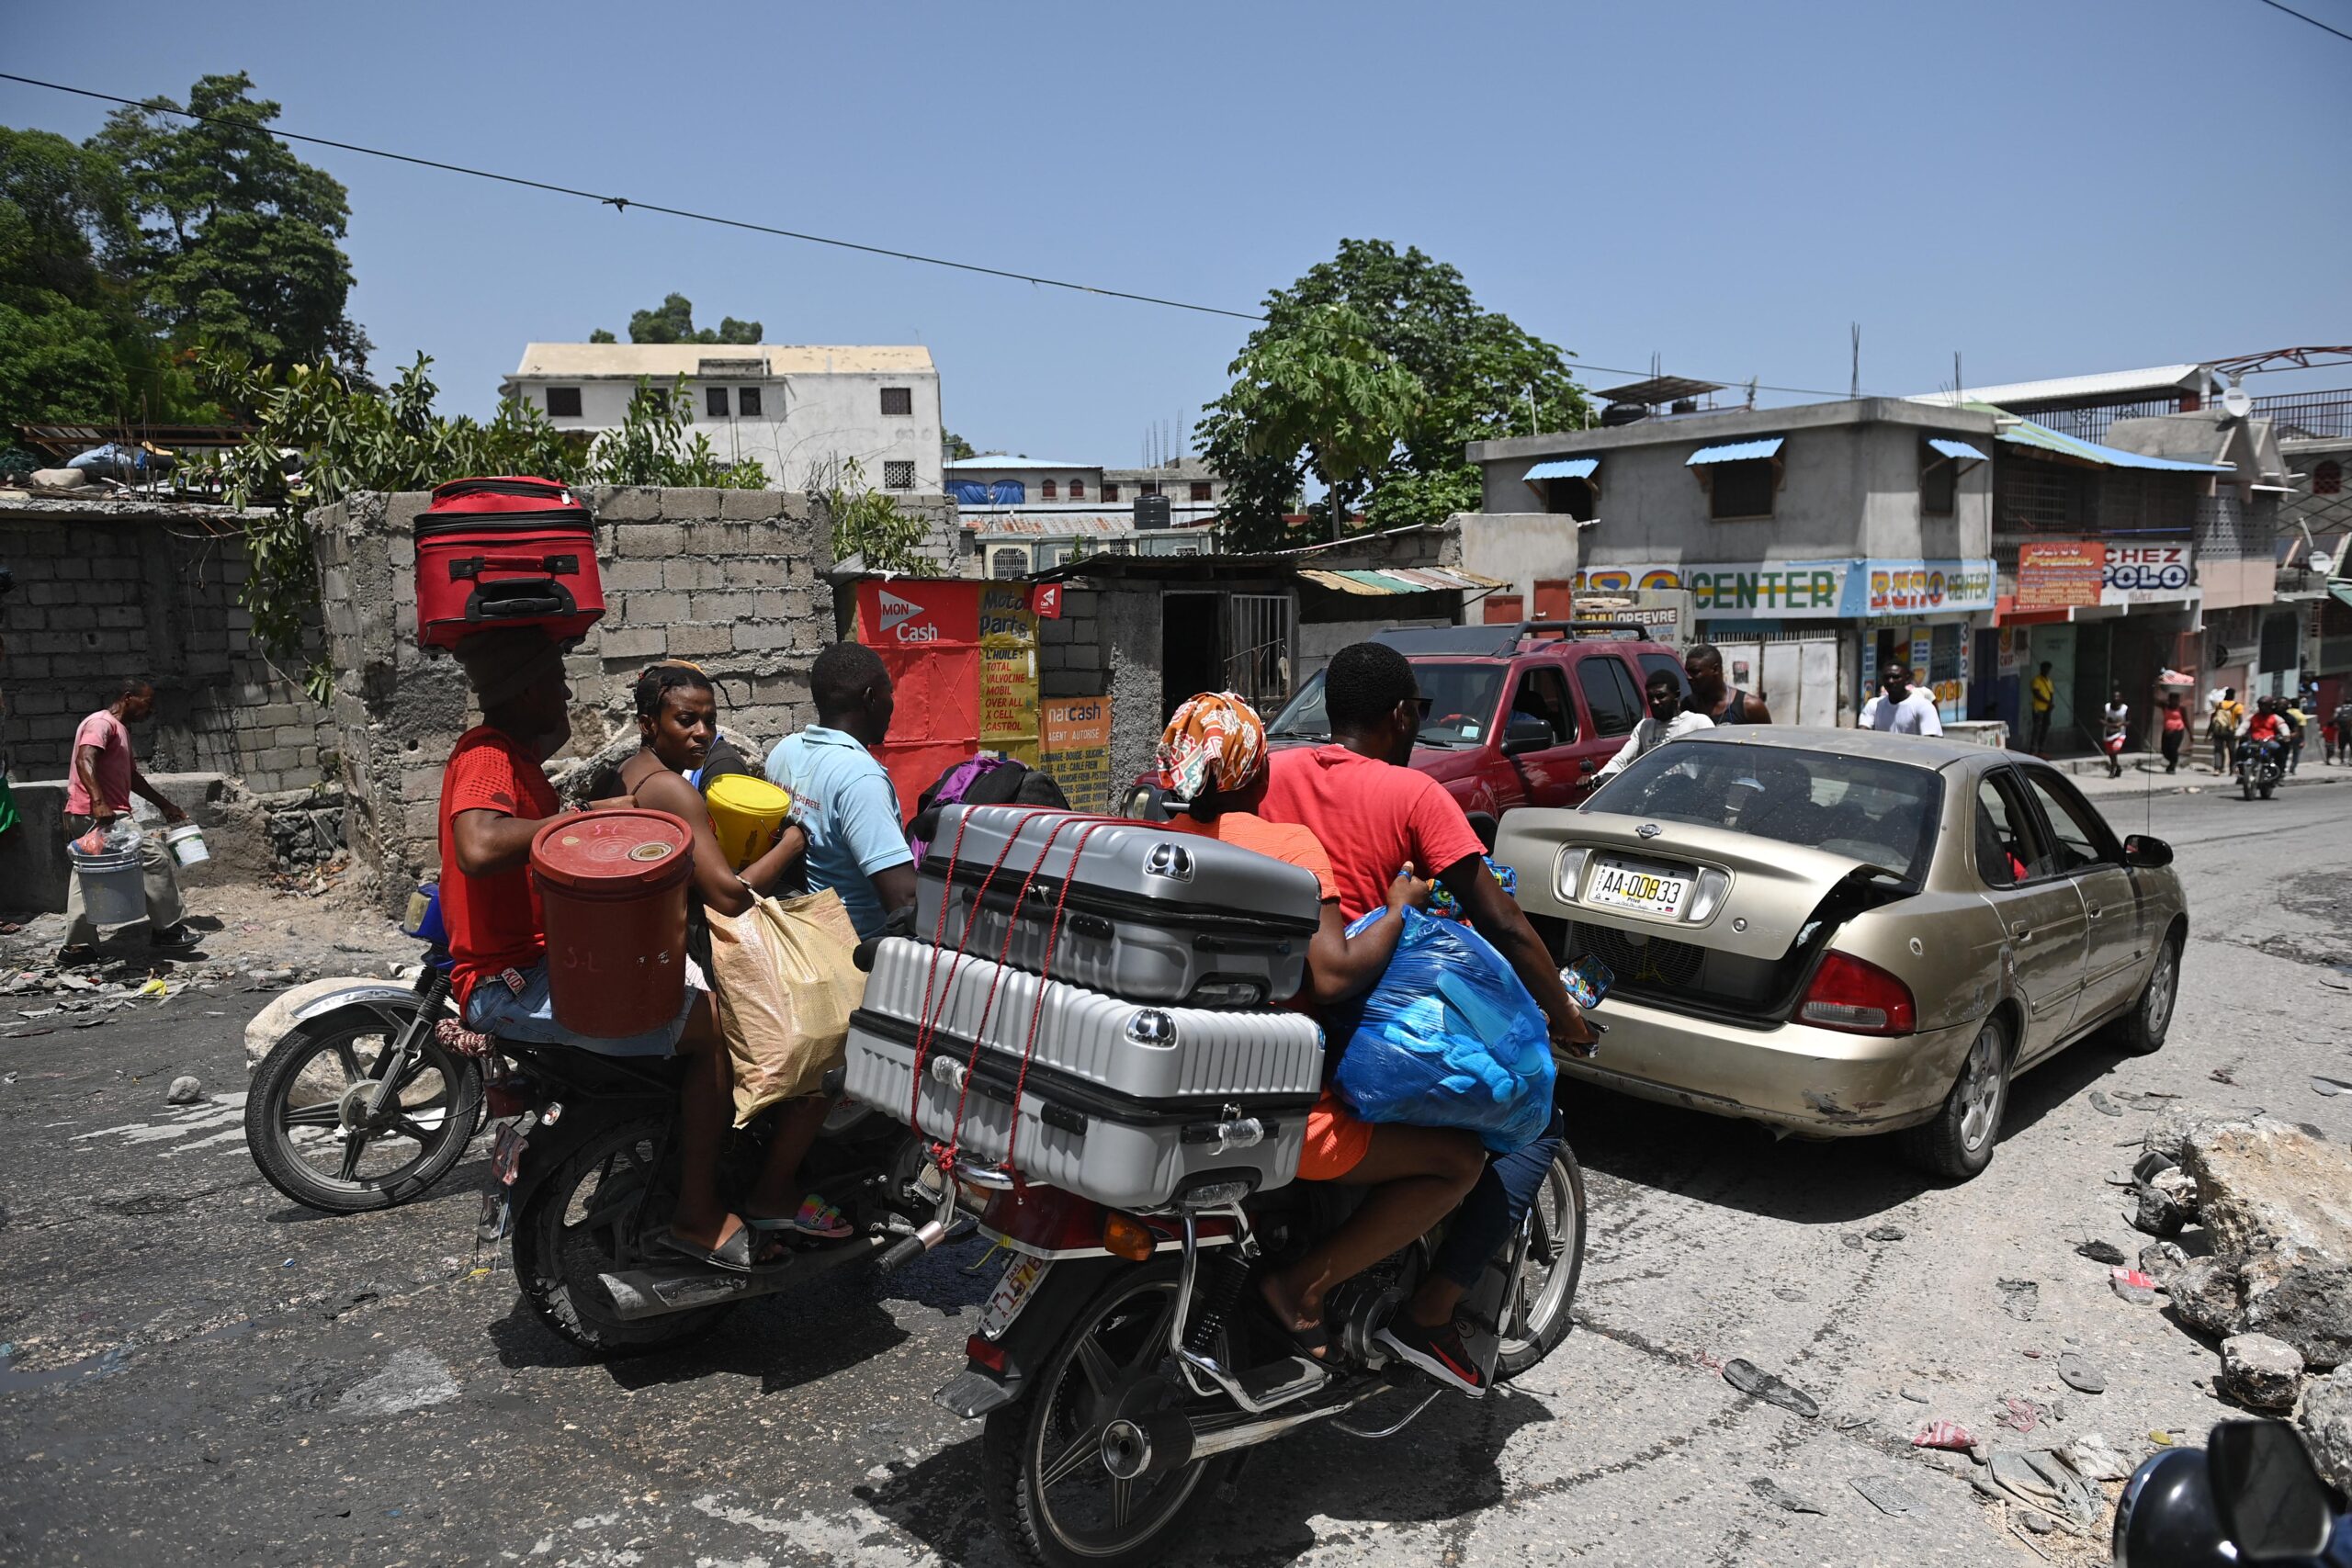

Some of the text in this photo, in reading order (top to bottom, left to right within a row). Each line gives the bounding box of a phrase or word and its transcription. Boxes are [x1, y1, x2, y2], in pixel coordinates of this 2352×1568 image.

[2104, 548, 2182, 563] CHEZ
[2102, 564, 2188, 590] POLO
[1692, 570, 1835, 609] CENTER
[984, 591, 1024, 612] Moto
[882, 604, 909, 615] MON
[896, 622, 938, 641] Cash
[979, 615, 1028, 638] Parts
[986, 662, 1012, 671] TOTAL
[986, 673, 1026, 684] VALVOLINE
[986, 686, 1012, 696] MOBIL
[1048, 701, 1101, 724] natcash
[985, 722, 1023, 732] CASTROL
[1047, 731, 1068, 742] AGENT
